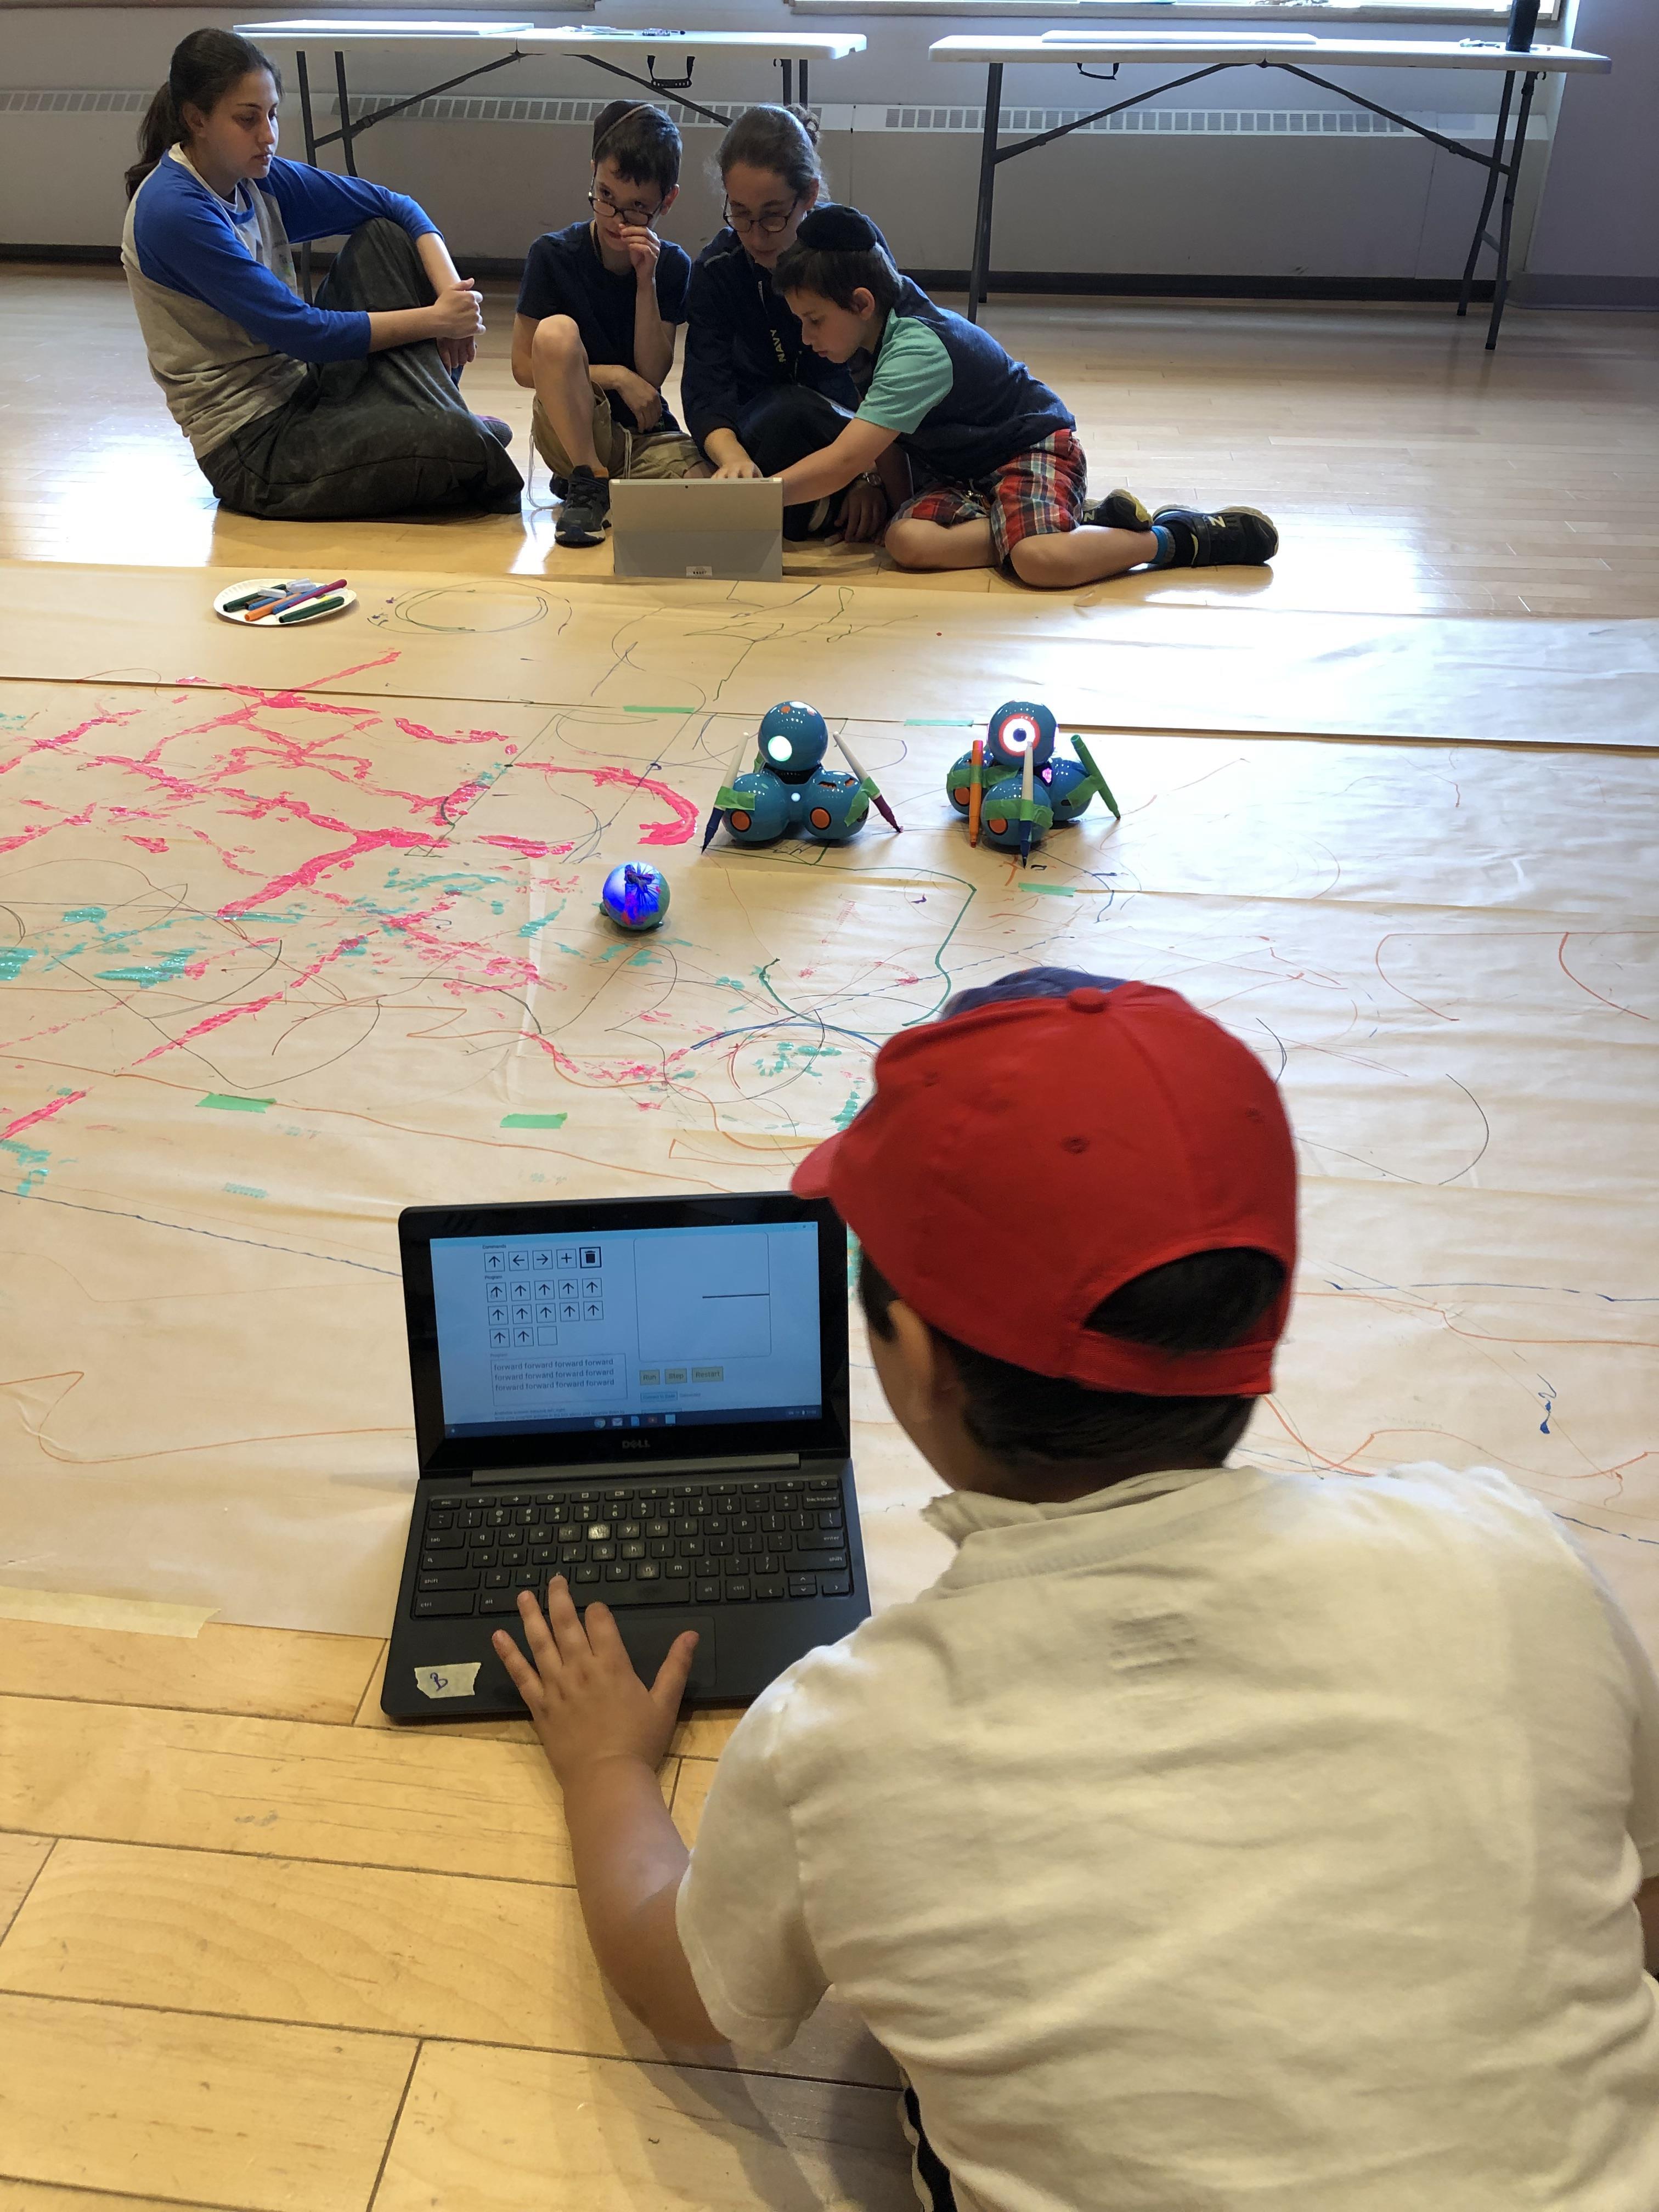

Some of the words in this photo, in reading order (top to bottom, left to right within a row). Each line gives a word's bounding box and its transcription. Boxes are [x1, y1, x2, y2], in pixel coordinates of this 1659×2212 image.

[770, 330, 786, 363] NAVY
[1208, 515, 1226, 528] N
[495, 1373, 523, 1381] forward
